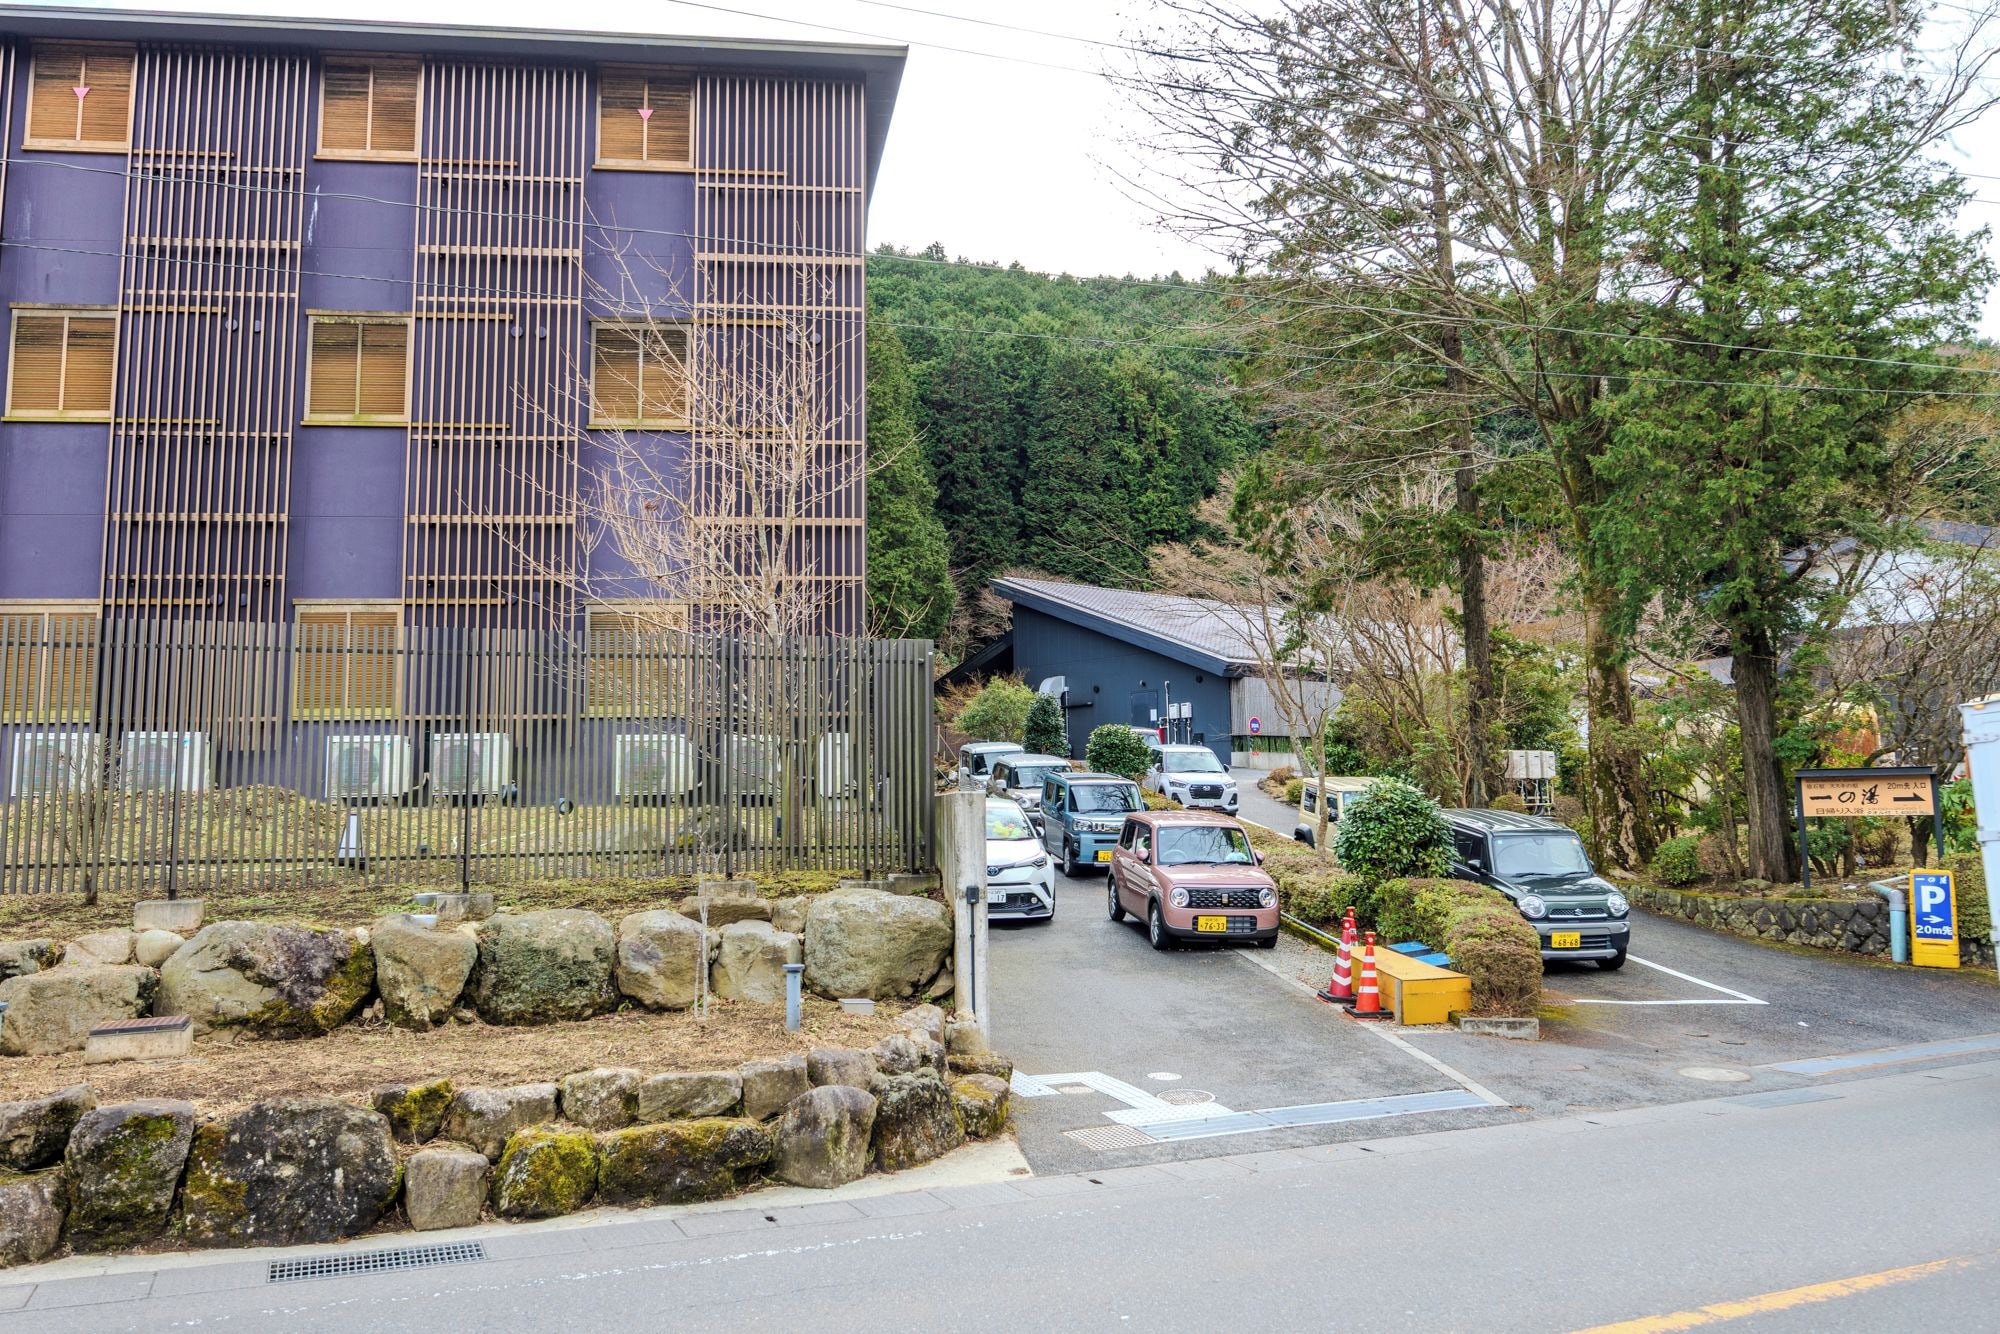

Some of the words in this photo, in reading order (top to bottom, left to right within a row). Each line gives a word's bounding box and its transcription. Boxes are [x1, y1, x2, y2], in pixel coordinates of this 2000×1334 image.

[1809, 784, 1880, 805] 一の湯
[1816, 807, 1864, 815] 日帰り入浴
[1921, 885, 1946, 913] P
[1916, 925, 1953, 936] 20m先
